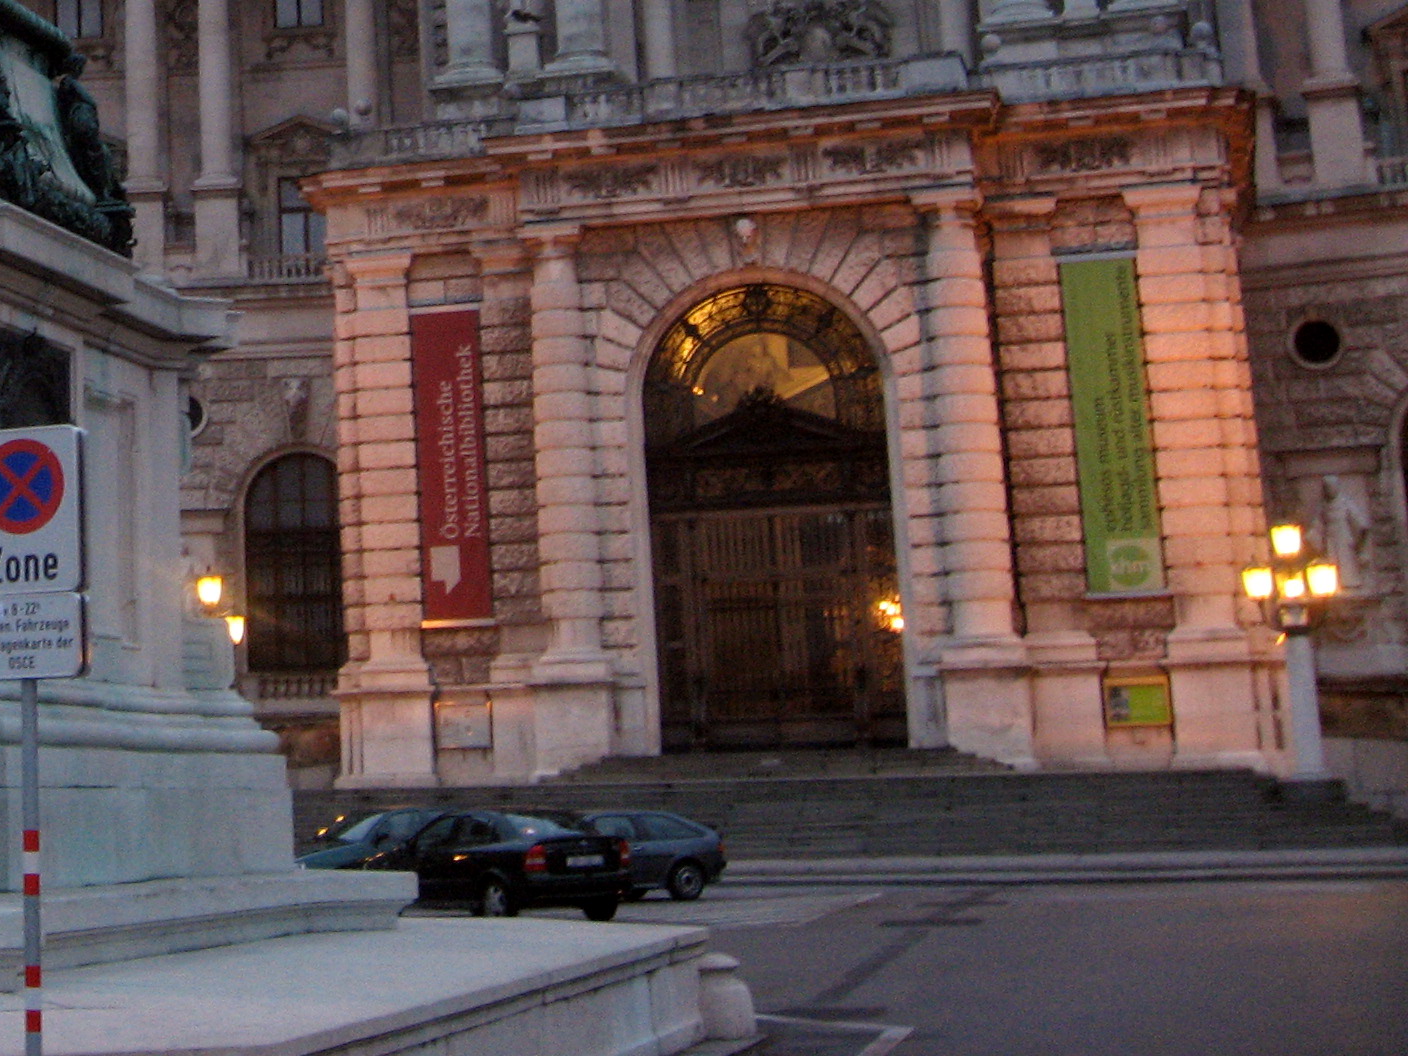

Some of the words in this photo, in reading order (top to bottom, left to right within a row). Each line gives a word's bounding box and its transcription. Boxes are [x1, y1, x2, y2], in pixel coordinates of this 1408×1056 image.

[436, 380, 460, 540] Österreichische
[455, 344, 481, 538] Nationalbibliothek
[1094, 396, 1109, 464] museum
[1112, 428, 1128, 461] und
